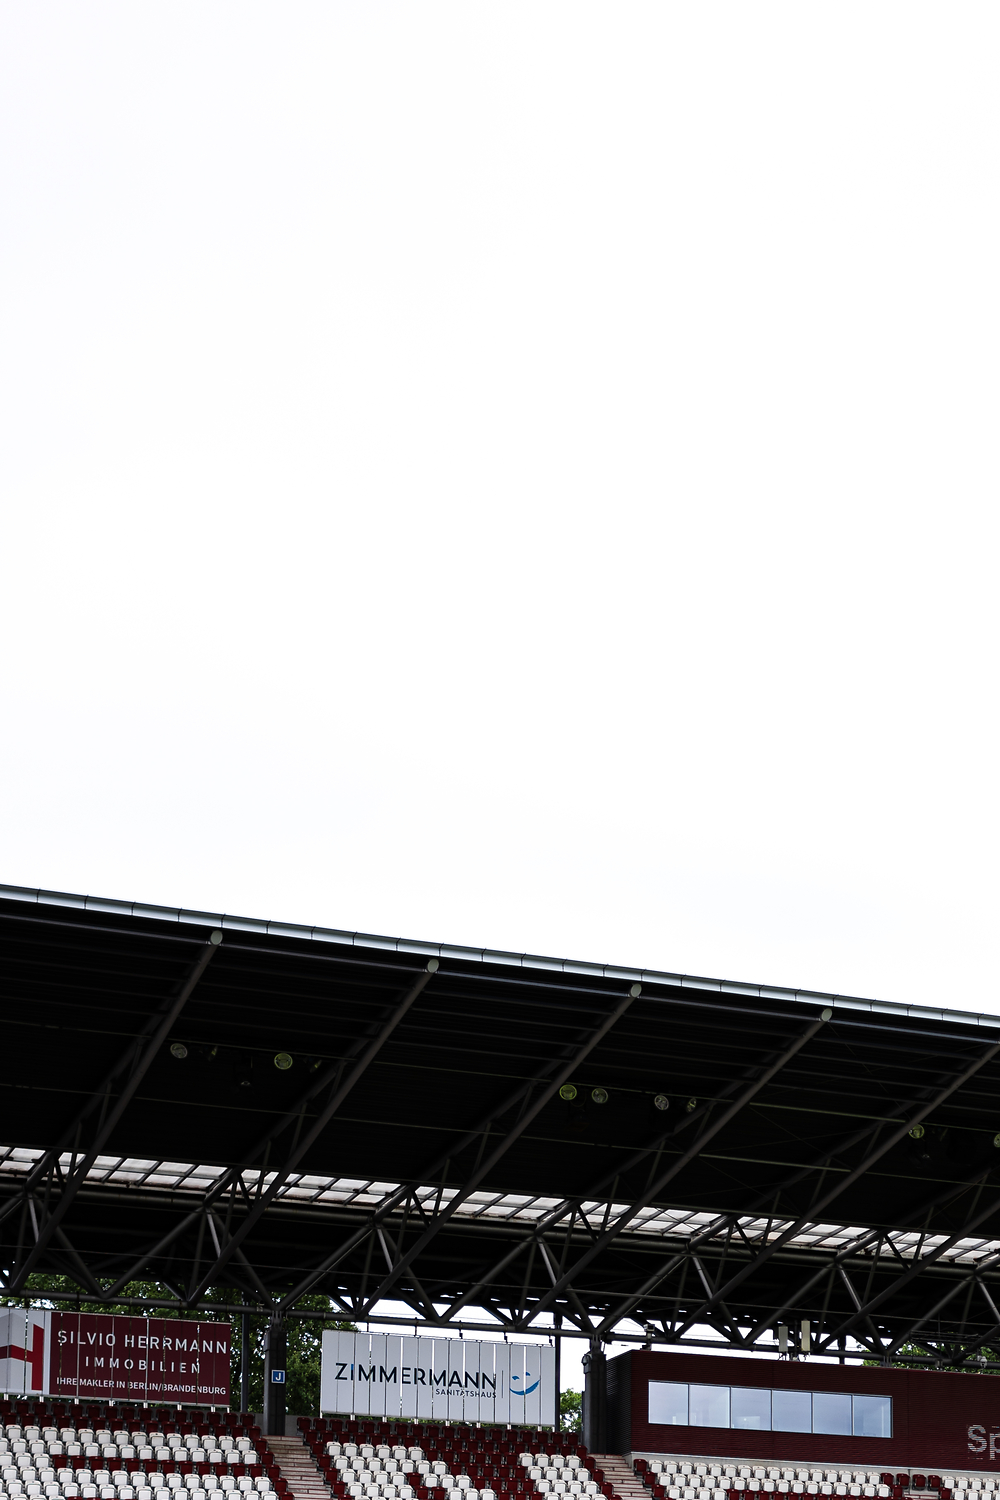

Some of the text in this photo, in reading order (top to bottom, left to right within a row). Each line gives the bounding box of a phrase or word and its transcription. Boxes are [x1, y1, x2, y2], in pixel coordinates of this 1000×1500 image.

[57, 1330, 228, 1354] SILVIO HERRMANN
[85, 1356, 201, 1374] IMMOBILIEN
[57, 1377, 78, 1386] IHRE
[79, 1378, 115, 1389] MAKLER
[116, 1380, 126, 1389] IN
[335, 1362, 497, 1390] ZIMMERMANN
